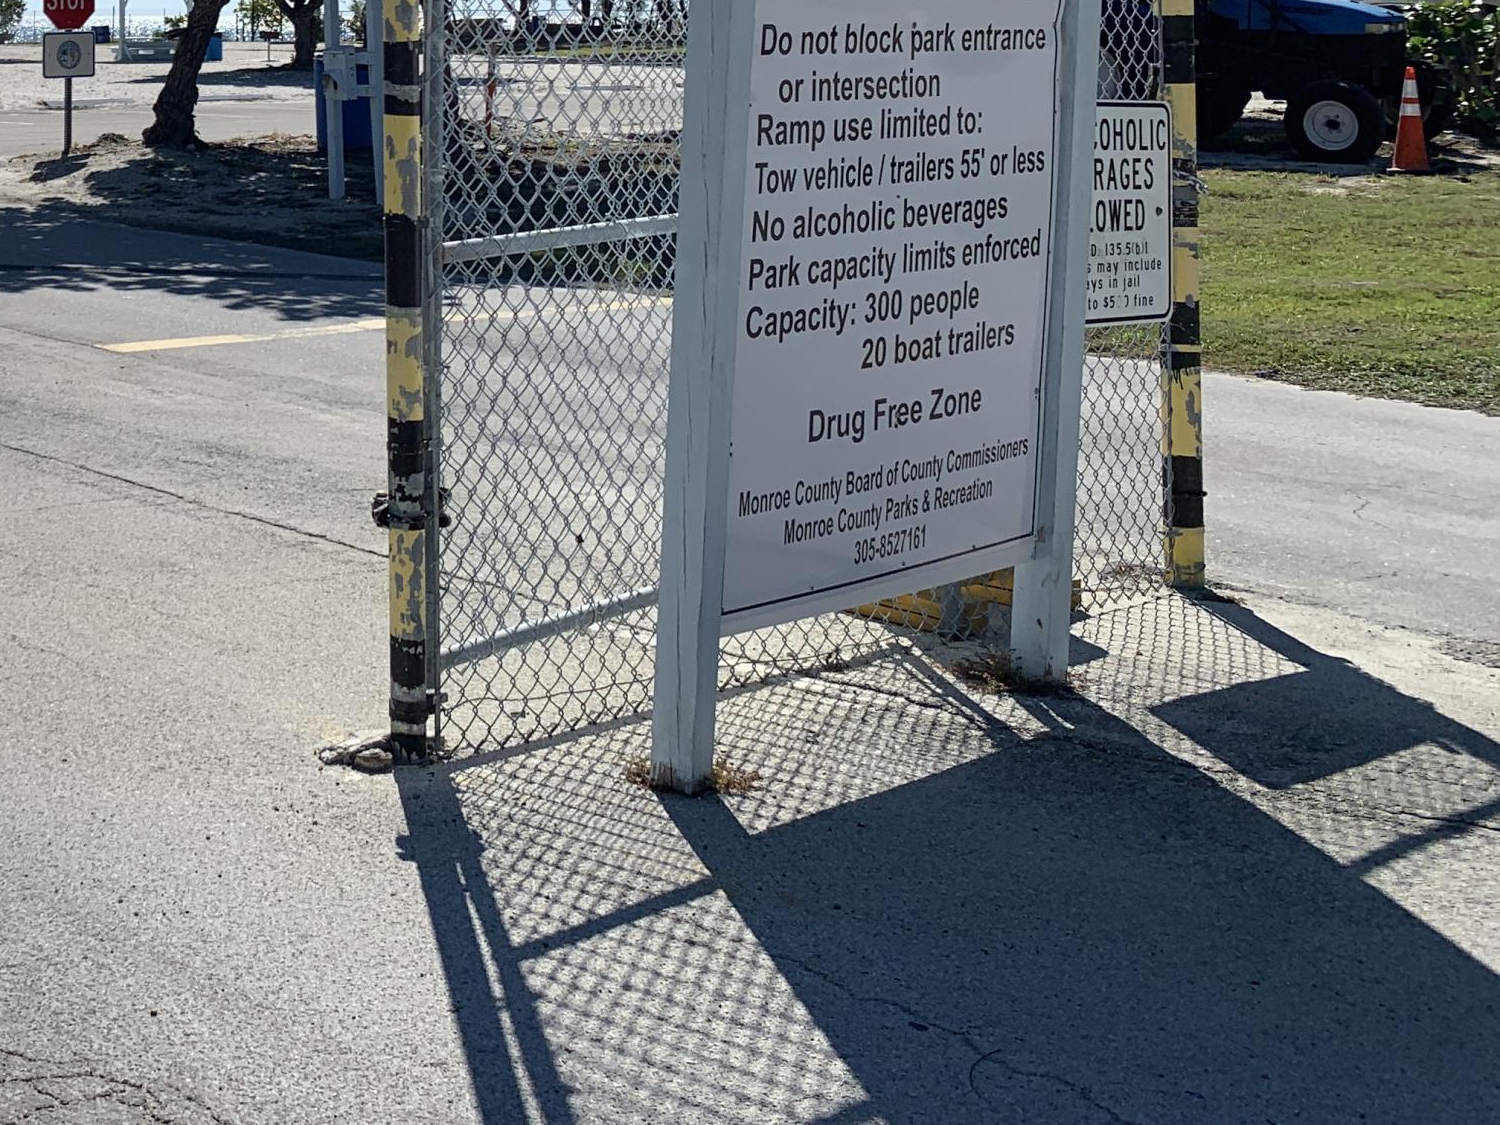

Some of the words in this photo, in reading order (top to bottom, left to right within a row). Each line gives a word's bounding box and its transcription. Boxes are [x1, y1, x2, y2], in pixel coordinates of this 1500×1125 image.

[760, 23, 793, 56] Do
[800, 28, 838, 55] not
[844, 22, 904, 54] block
[910, 22, 955, 60] park
[961, 24, 1046, 51] entrance
[778, 78, 804, 103] or
[811, 68, 941, 102] intersection
[757, 114, 825, 151] Ramp
[833, 118, 873, 142] use
[880, 105, 951, 140] limited
[956, 107, 983, 135] to:
[1093, 118, 1166, 151] OHOLIC
[755, 162, 797, 195] Tow
[803, 154, 873, 190] vehicle
[877, 154, 886, 186] /
[890, 152, 955, 185] trailers
[960, 147, 985, 179] 55'
[990, 153, 1008, 176] or
[1012, 145, 1045, 174] less
[751, 210, 785, 243] No
[792, 201, 896, 239] alcoholic
[902, 195, 1008, 229] beverages
[1089, 199, 1146, 233] OWED
[749, 255, 800, 291] Park
[807, 246, 896, 289] capacity
[902, 240, 956, 274] limits
[962, 229, 1041, 266] enforced
[1096, 261, 1119, 276] may
[1124, 257, 1162, 272] include
[1108, 275, 1118, 288] in
[1122, 274, 1140, 292] jail
[745, 298, 857, 343] Capacity:
[864, 289, 902, 324] 300
[909, 281, 980, 324] people
[1088, 298, 1098, 310] to
[1133, 293, 1154, 307] fine
[860, 336, 887, 369] 20
[894, 328, 941, 364] boat
[947, 321, 1015, 356] trailers
[808, 408, 865, 443] Drug
[873, 398, 922, 431] Free
[929, 388, 982, 421] Zone
[738, 490, 791, 517] Monroe
[794, 474, 842, 506] County
[845, 464, 883, 496] Board
[886, 461, 899, 486] of
[901, 453, 943, 484] County
[946, 436, 1029, 473] Commissioners
[783, 519, 834, 545] Monroe
[837, 502, 882, 533] County
[885, 493, 918, 522] Parks
[922, 490, 931, 514] &
[934, 478, 993, 510] Recreation
[853, 524, 927, 565] 305-8527161
